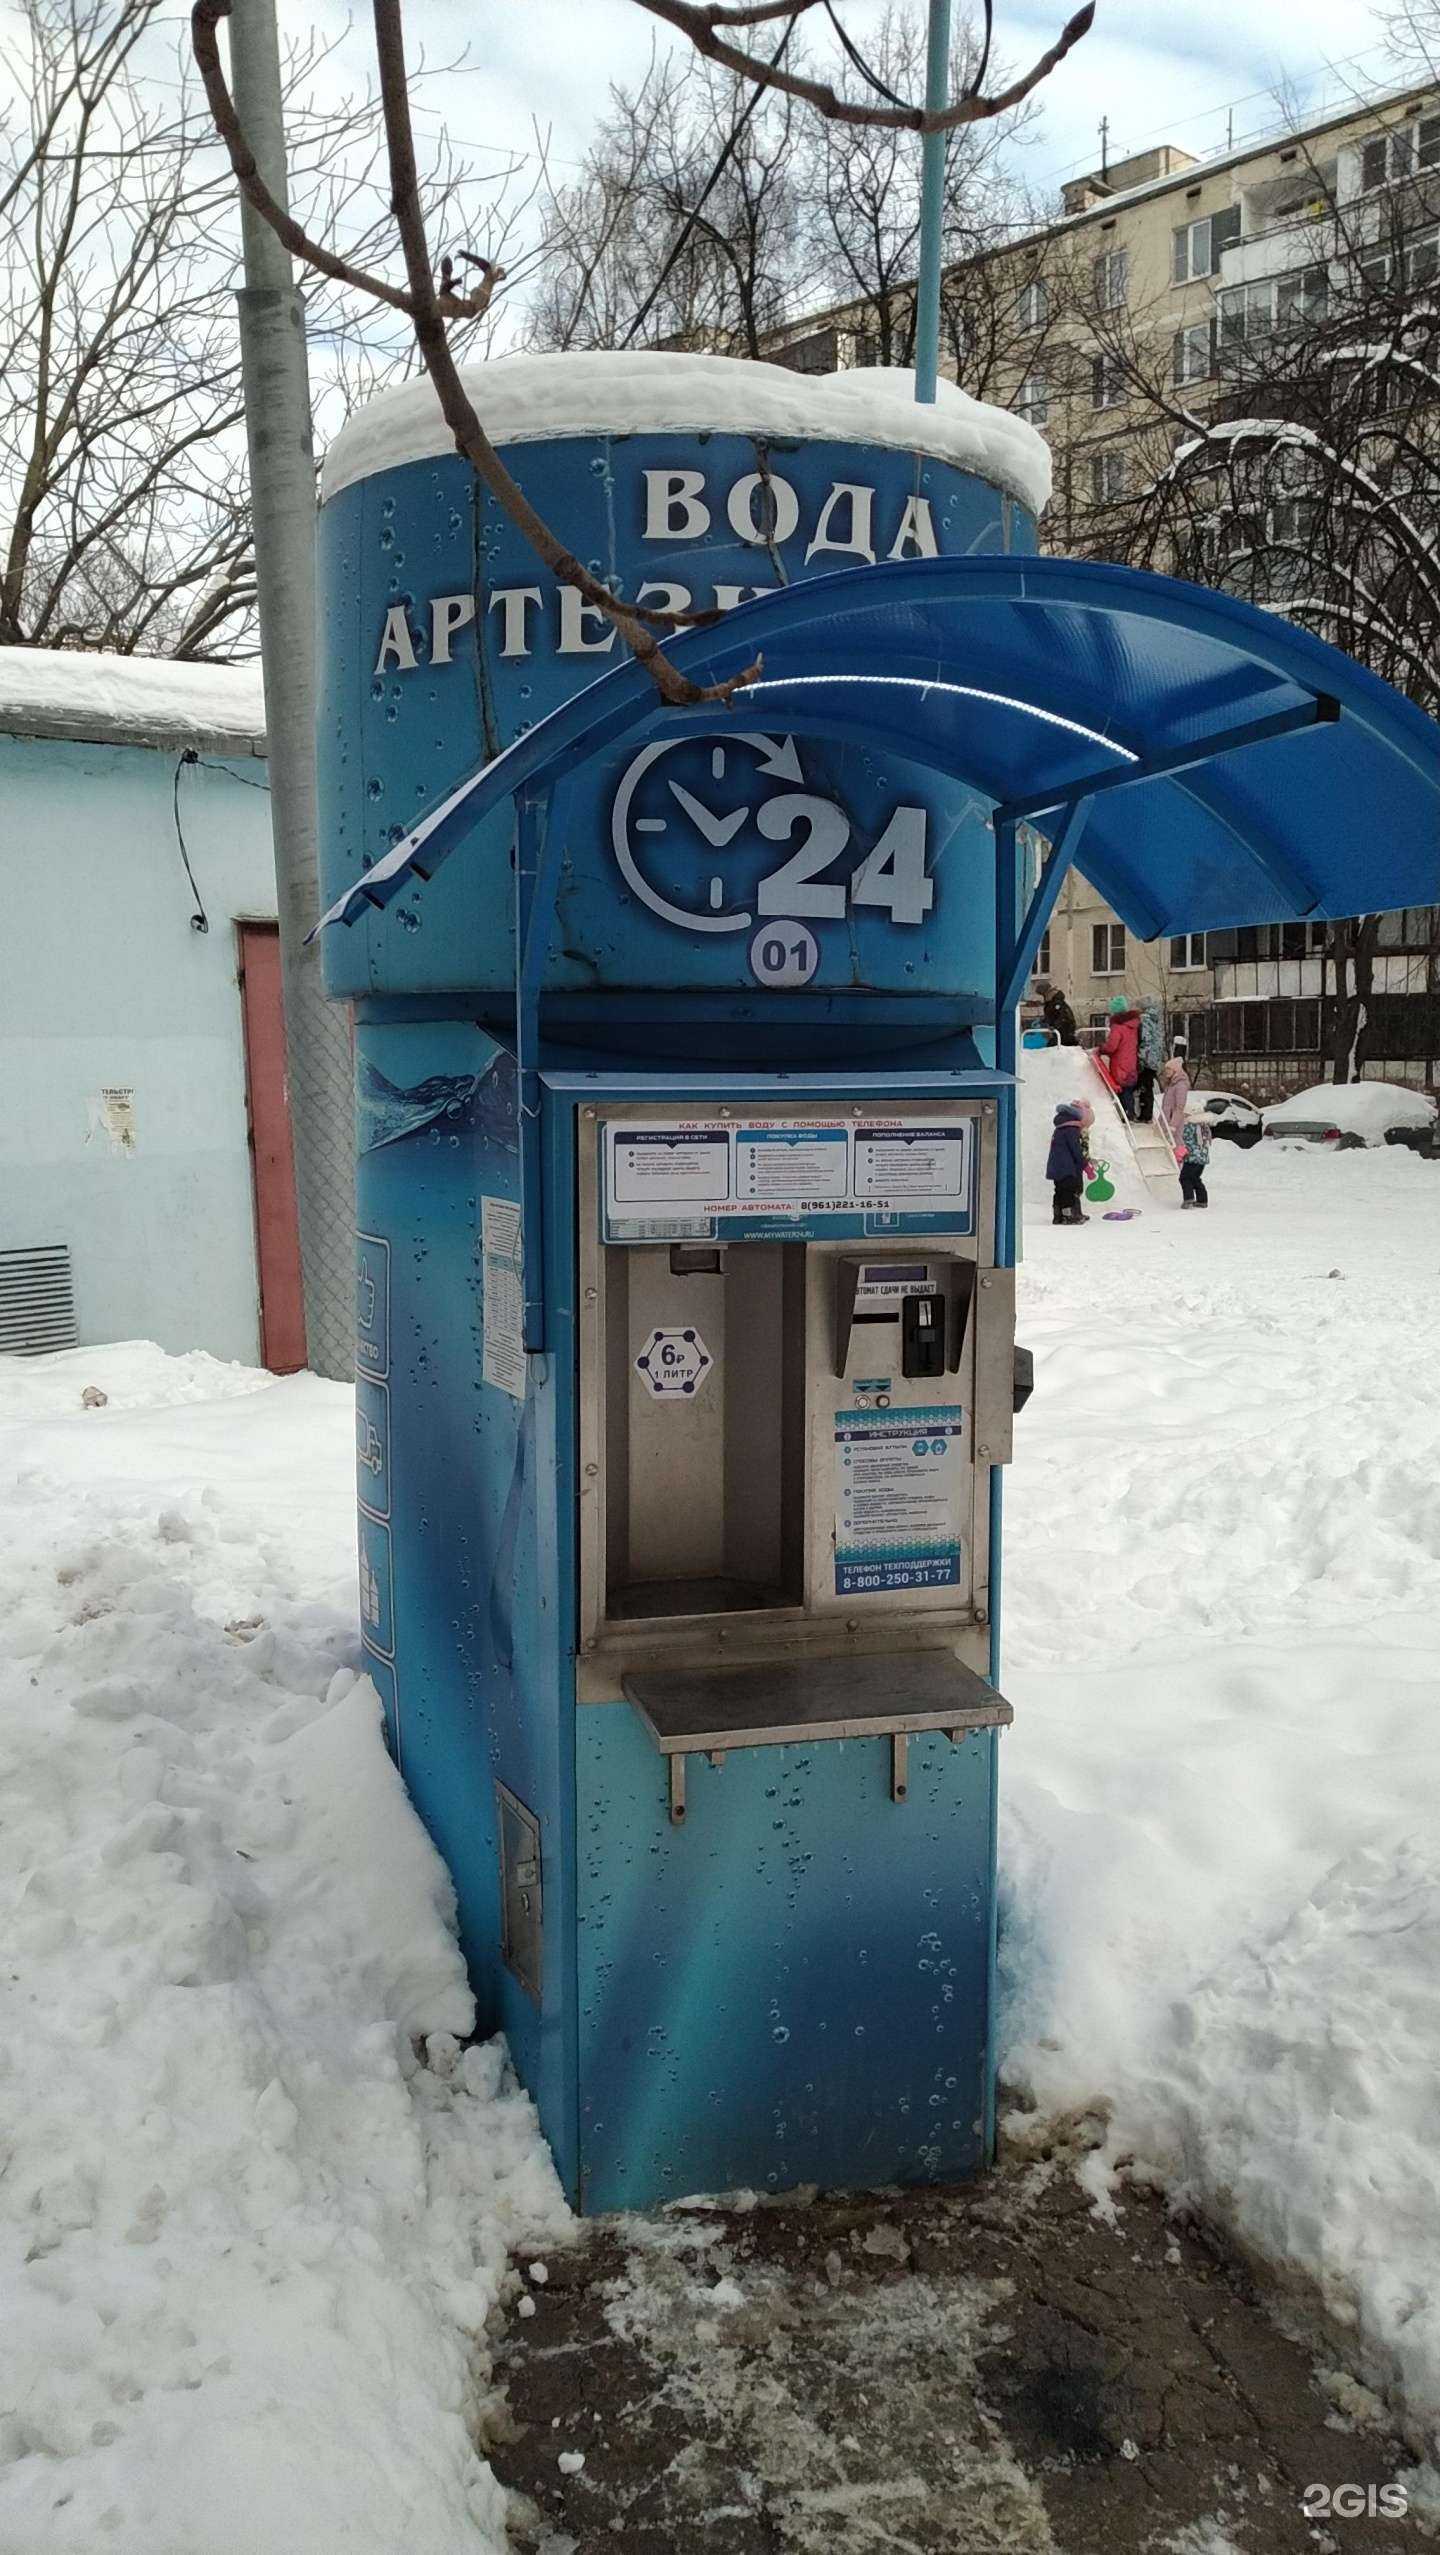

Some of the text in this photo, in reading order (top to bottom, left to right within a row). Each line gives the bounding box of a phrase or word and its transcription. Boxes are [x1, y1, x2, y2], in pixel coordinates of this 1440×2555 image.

[642, 470, 941, 566] ВОДА
[757, 794, 935, 924] 24
[762, 942, 809, 973] 01
[678, 1119, 904, 1130] КАК КУПИТЬ ВОДУ С ПОМОЩЬЮ ТЕЛЕФОНА
[704, 1204, 738, 1212] НОМЕР
[800, 1200, 890, 1212] 8(961)221-16-51
[881, 1286, 900, 1295] СДАЧИ
[901, 1286, 909, 1294] НЕ
[663, 1370, 693, 1379] ЛИТР
[869, 1428, 928, 1438] ИНСТРУКЦИЯ
[843, 1558, 952, 1574] ТЕЛЕФОН ТЕХПОДДЕРЖКИ
[843, 1569, 951, 1589] 8-800-250-31-77
